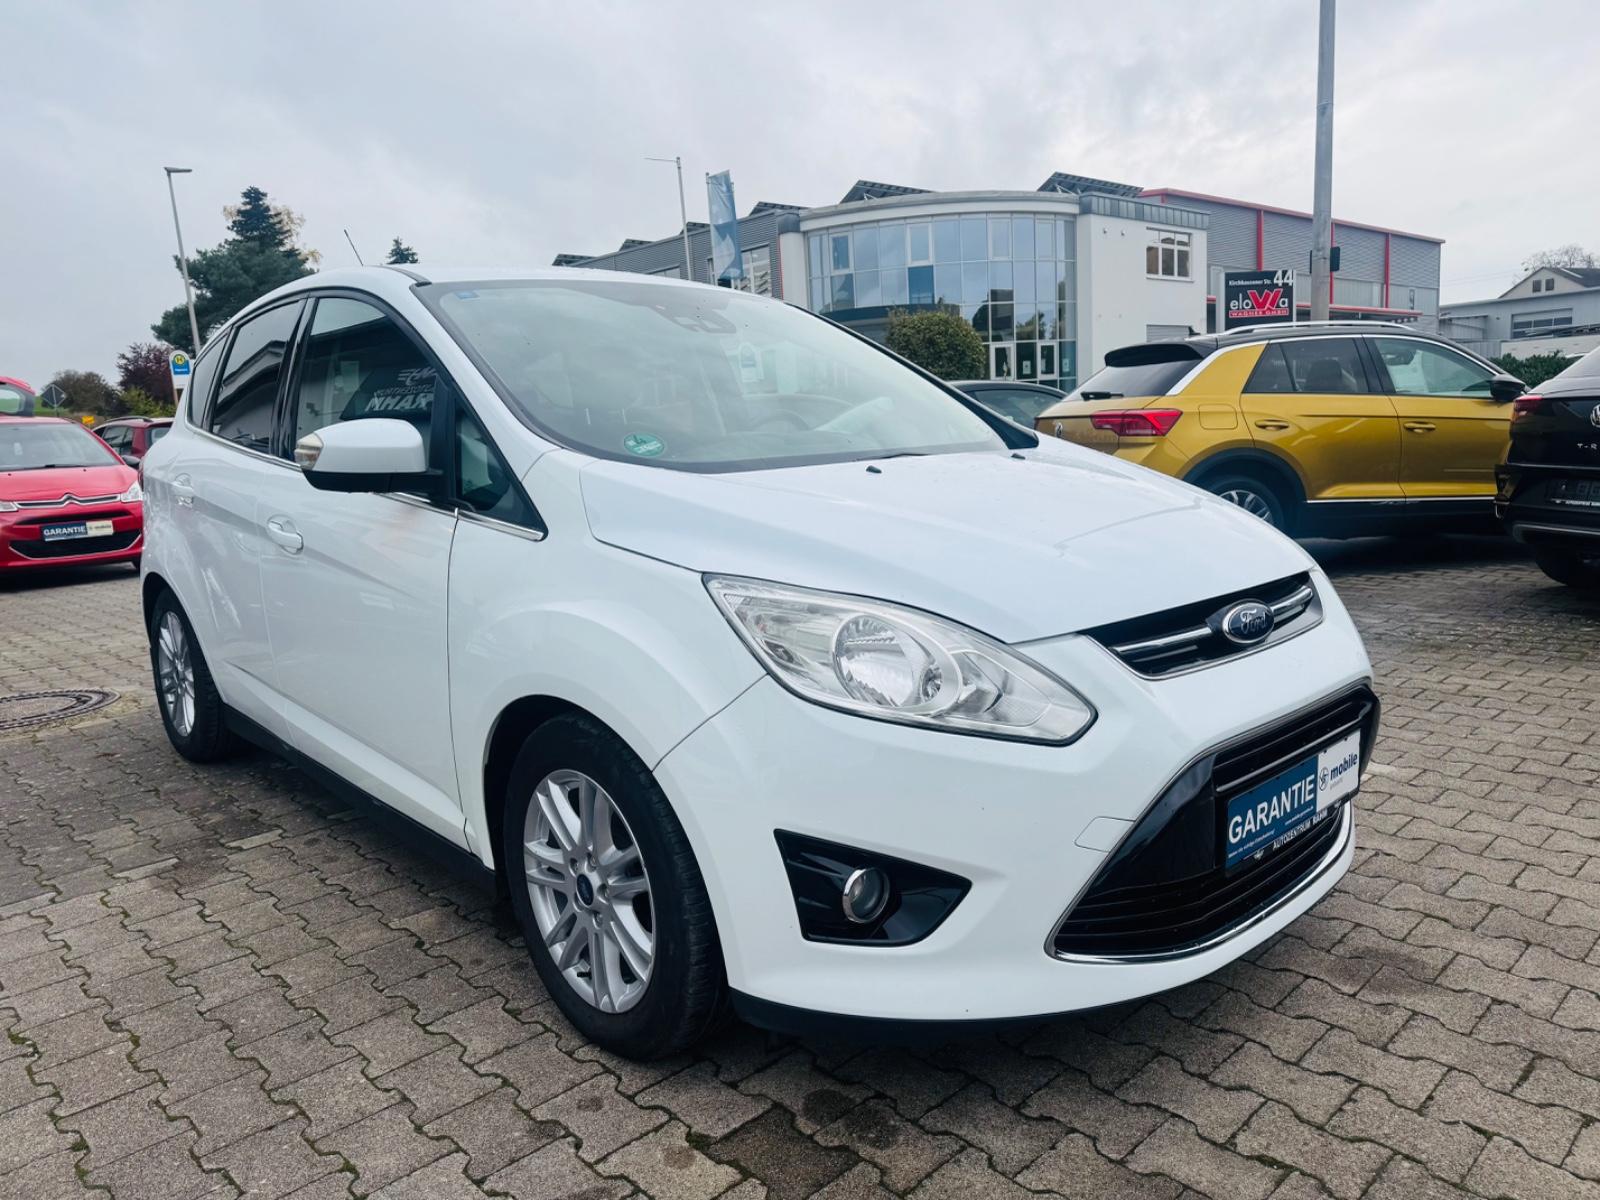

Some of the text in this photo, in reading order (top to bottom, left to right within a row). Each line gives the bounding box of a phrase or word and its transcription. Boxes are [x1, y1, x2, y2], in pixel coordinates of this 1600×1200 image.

[1274, 270, 1293, 286] 44
[43, 525, 86, 536] GARANTIE
[1240, 608, 1268, 634] Ford
[1330, 753, 1358, 780] mobile
[1228, 774, 1315, 844] GARANTIE
